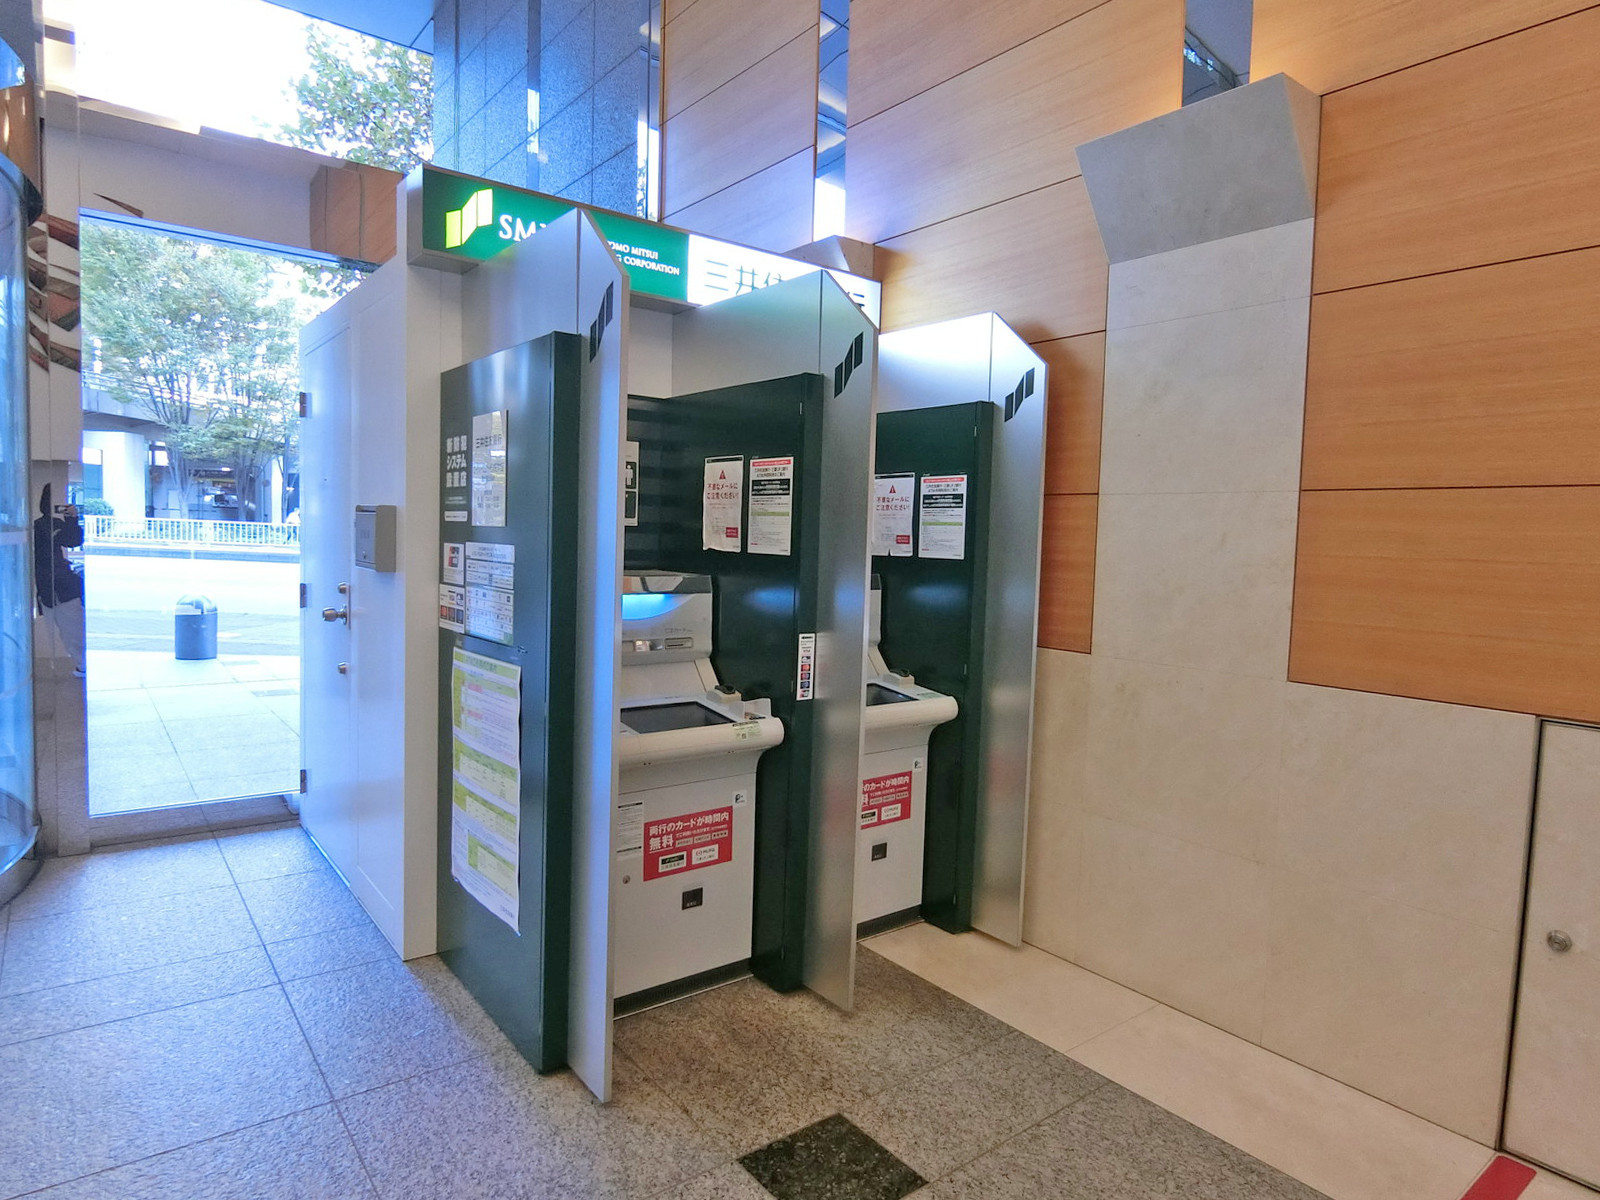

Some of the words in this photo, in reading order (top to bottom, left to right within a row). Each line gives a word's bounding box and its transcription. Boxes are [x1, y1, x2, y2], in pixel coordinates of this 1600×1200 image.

[498, 214, 547, 242] SM
[607, 240, 630, 253] OMO
[631, 246, 659, 260] MITSUI
[623, 256, 680, 276] CORPORATION
[446, 453, 467, 471] システム
[649, 812, 729, 836] 両行のカードが時間内
[649, 834, 674, 851] 無料
